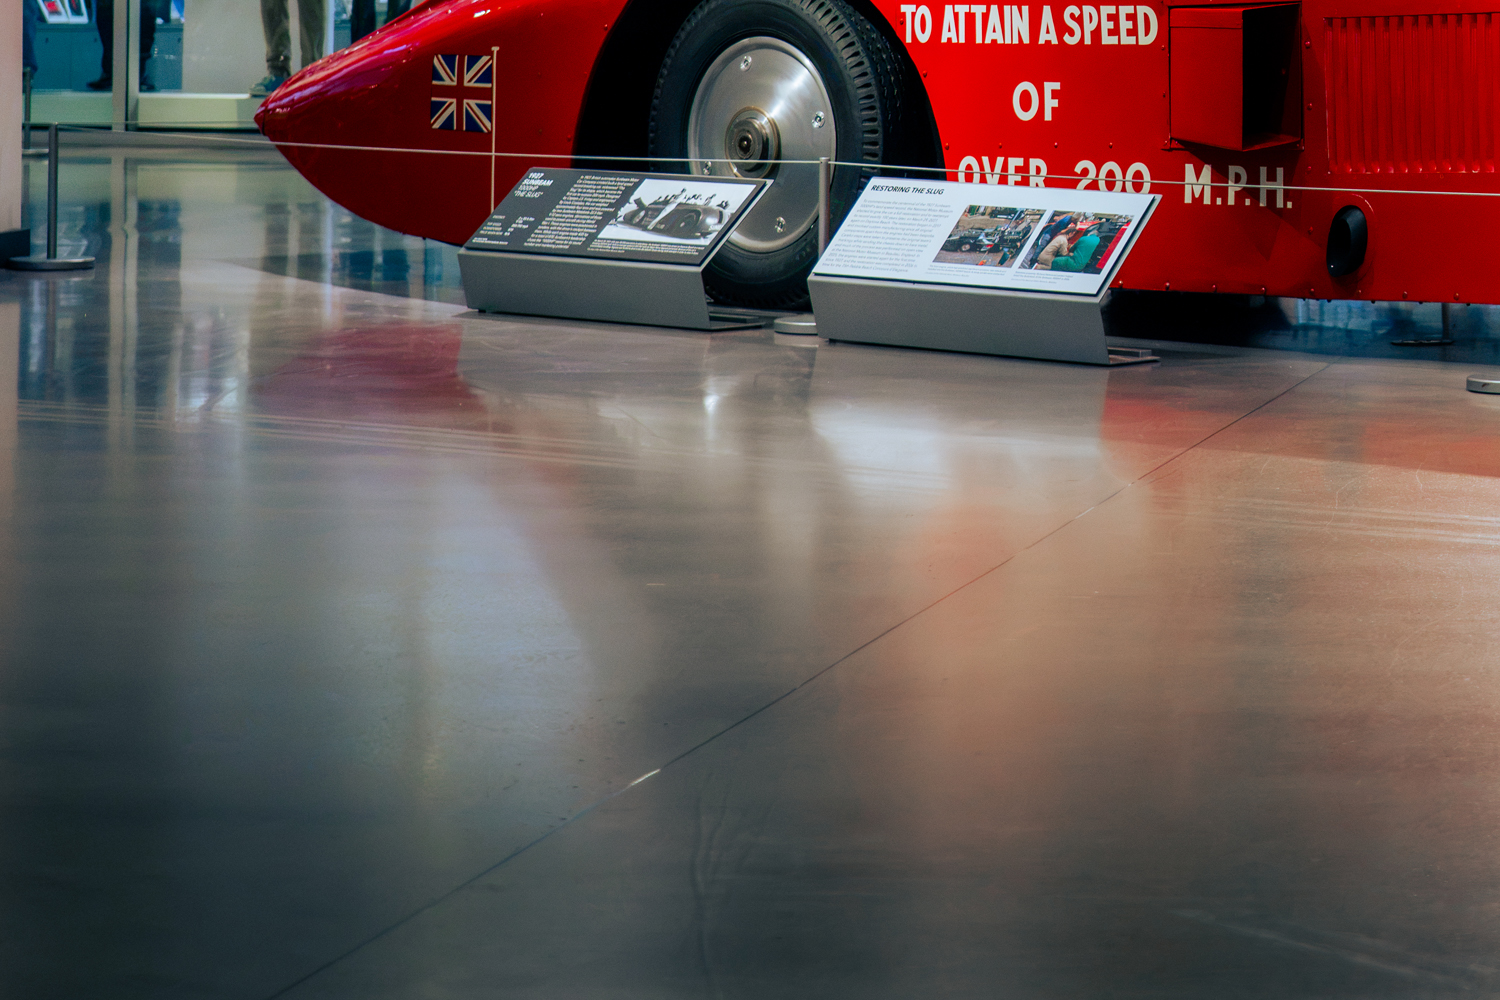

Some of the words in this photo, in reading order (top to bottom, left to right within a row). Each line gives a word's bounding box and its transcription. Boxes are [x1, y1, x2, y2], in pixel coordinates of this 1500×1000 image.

[901, 5, 932, 43] TO
[941, 5, 1029, 44] ATTAIN
[1039, 6, 1058, 44] A
[1063, 5, 1158, 45] SPEED
[1012, 82, 1061, 121] OF
[871, 185, 910, 193] RESTORING
[958, 156, 1048, 187] OVER
[1074, 160, 1150, 194] 200
[1184, 163, 1293, 208] M.P.H.
